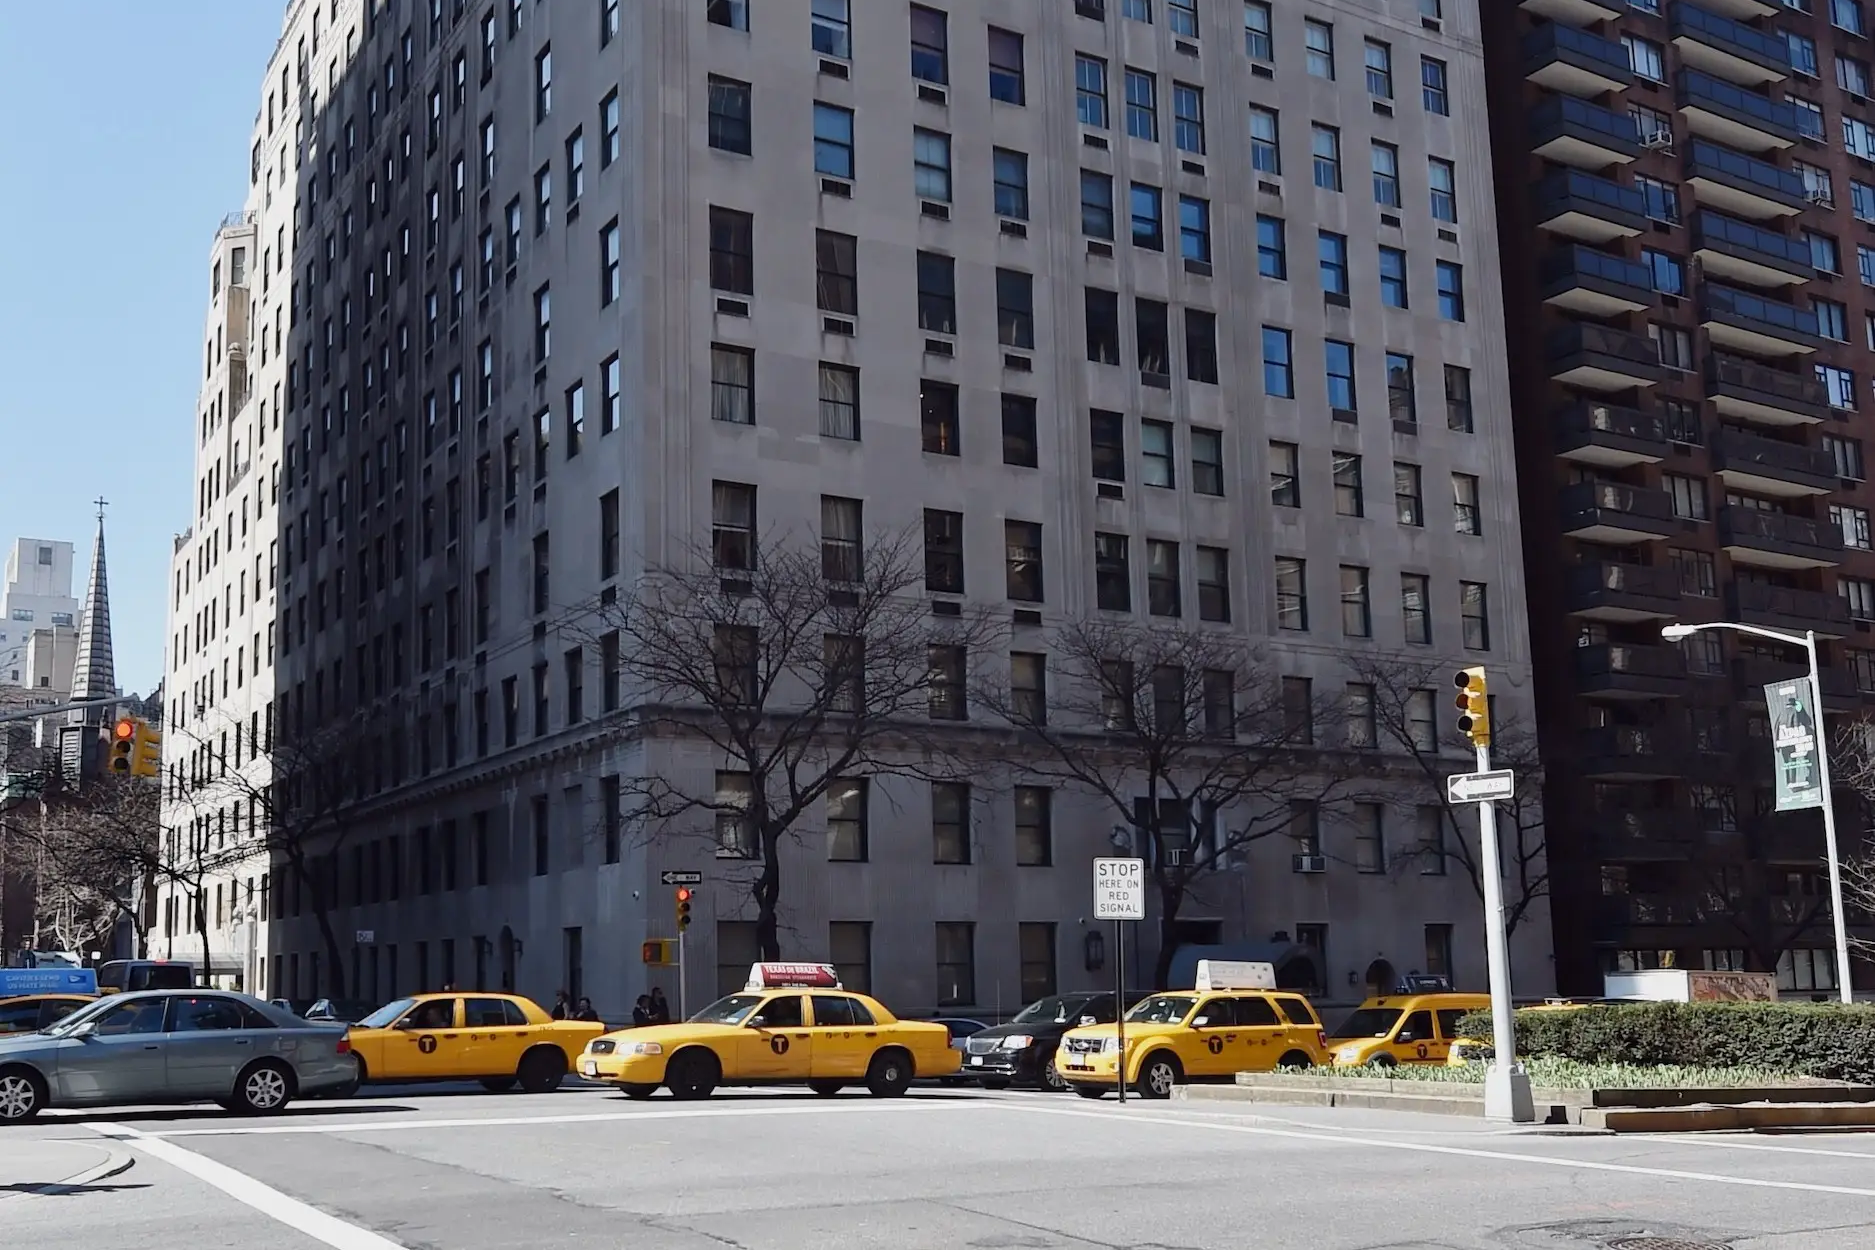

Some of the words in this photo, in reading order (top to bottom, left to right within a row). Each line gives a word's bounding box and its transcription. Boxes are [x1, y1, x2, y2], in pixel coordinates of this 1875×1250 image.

[1099, 863, 1139, 876] STOP
[1099, 879, 1123, 889] HERE
[1126, 879, 1139, 889] ON
[1108, 891, 1129, 901] RED
[1099, 903, 1139, 913] SIGNAL
[422, 1038, 433, 1052] T
[774, 1037, 785, 1052] T
